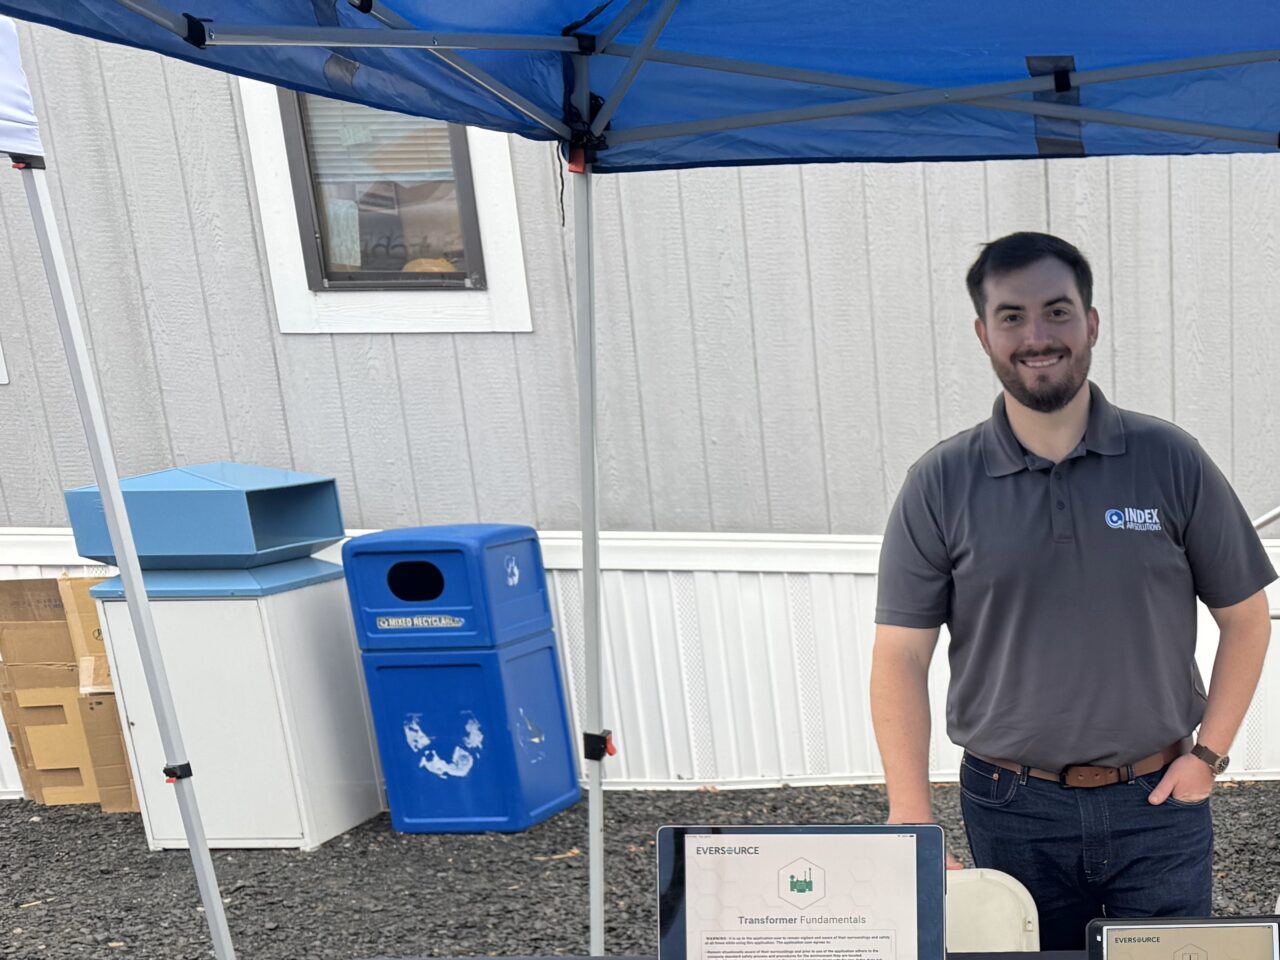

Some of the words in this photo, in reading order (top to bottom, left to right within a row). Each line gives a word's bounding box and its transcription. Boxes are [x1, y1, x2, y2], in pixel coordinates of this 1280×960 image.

[1125, 508, 1159, 523] INDEX
[1134, 523, 1162, 531] SOLUTIONS
[389, 617, 412, 627] MIXED
[696, 846, 760, 855] EVERSOURCE
[738, 915, 798, 925] Transformer
[800, 915, 866, 925] Fundamentals
